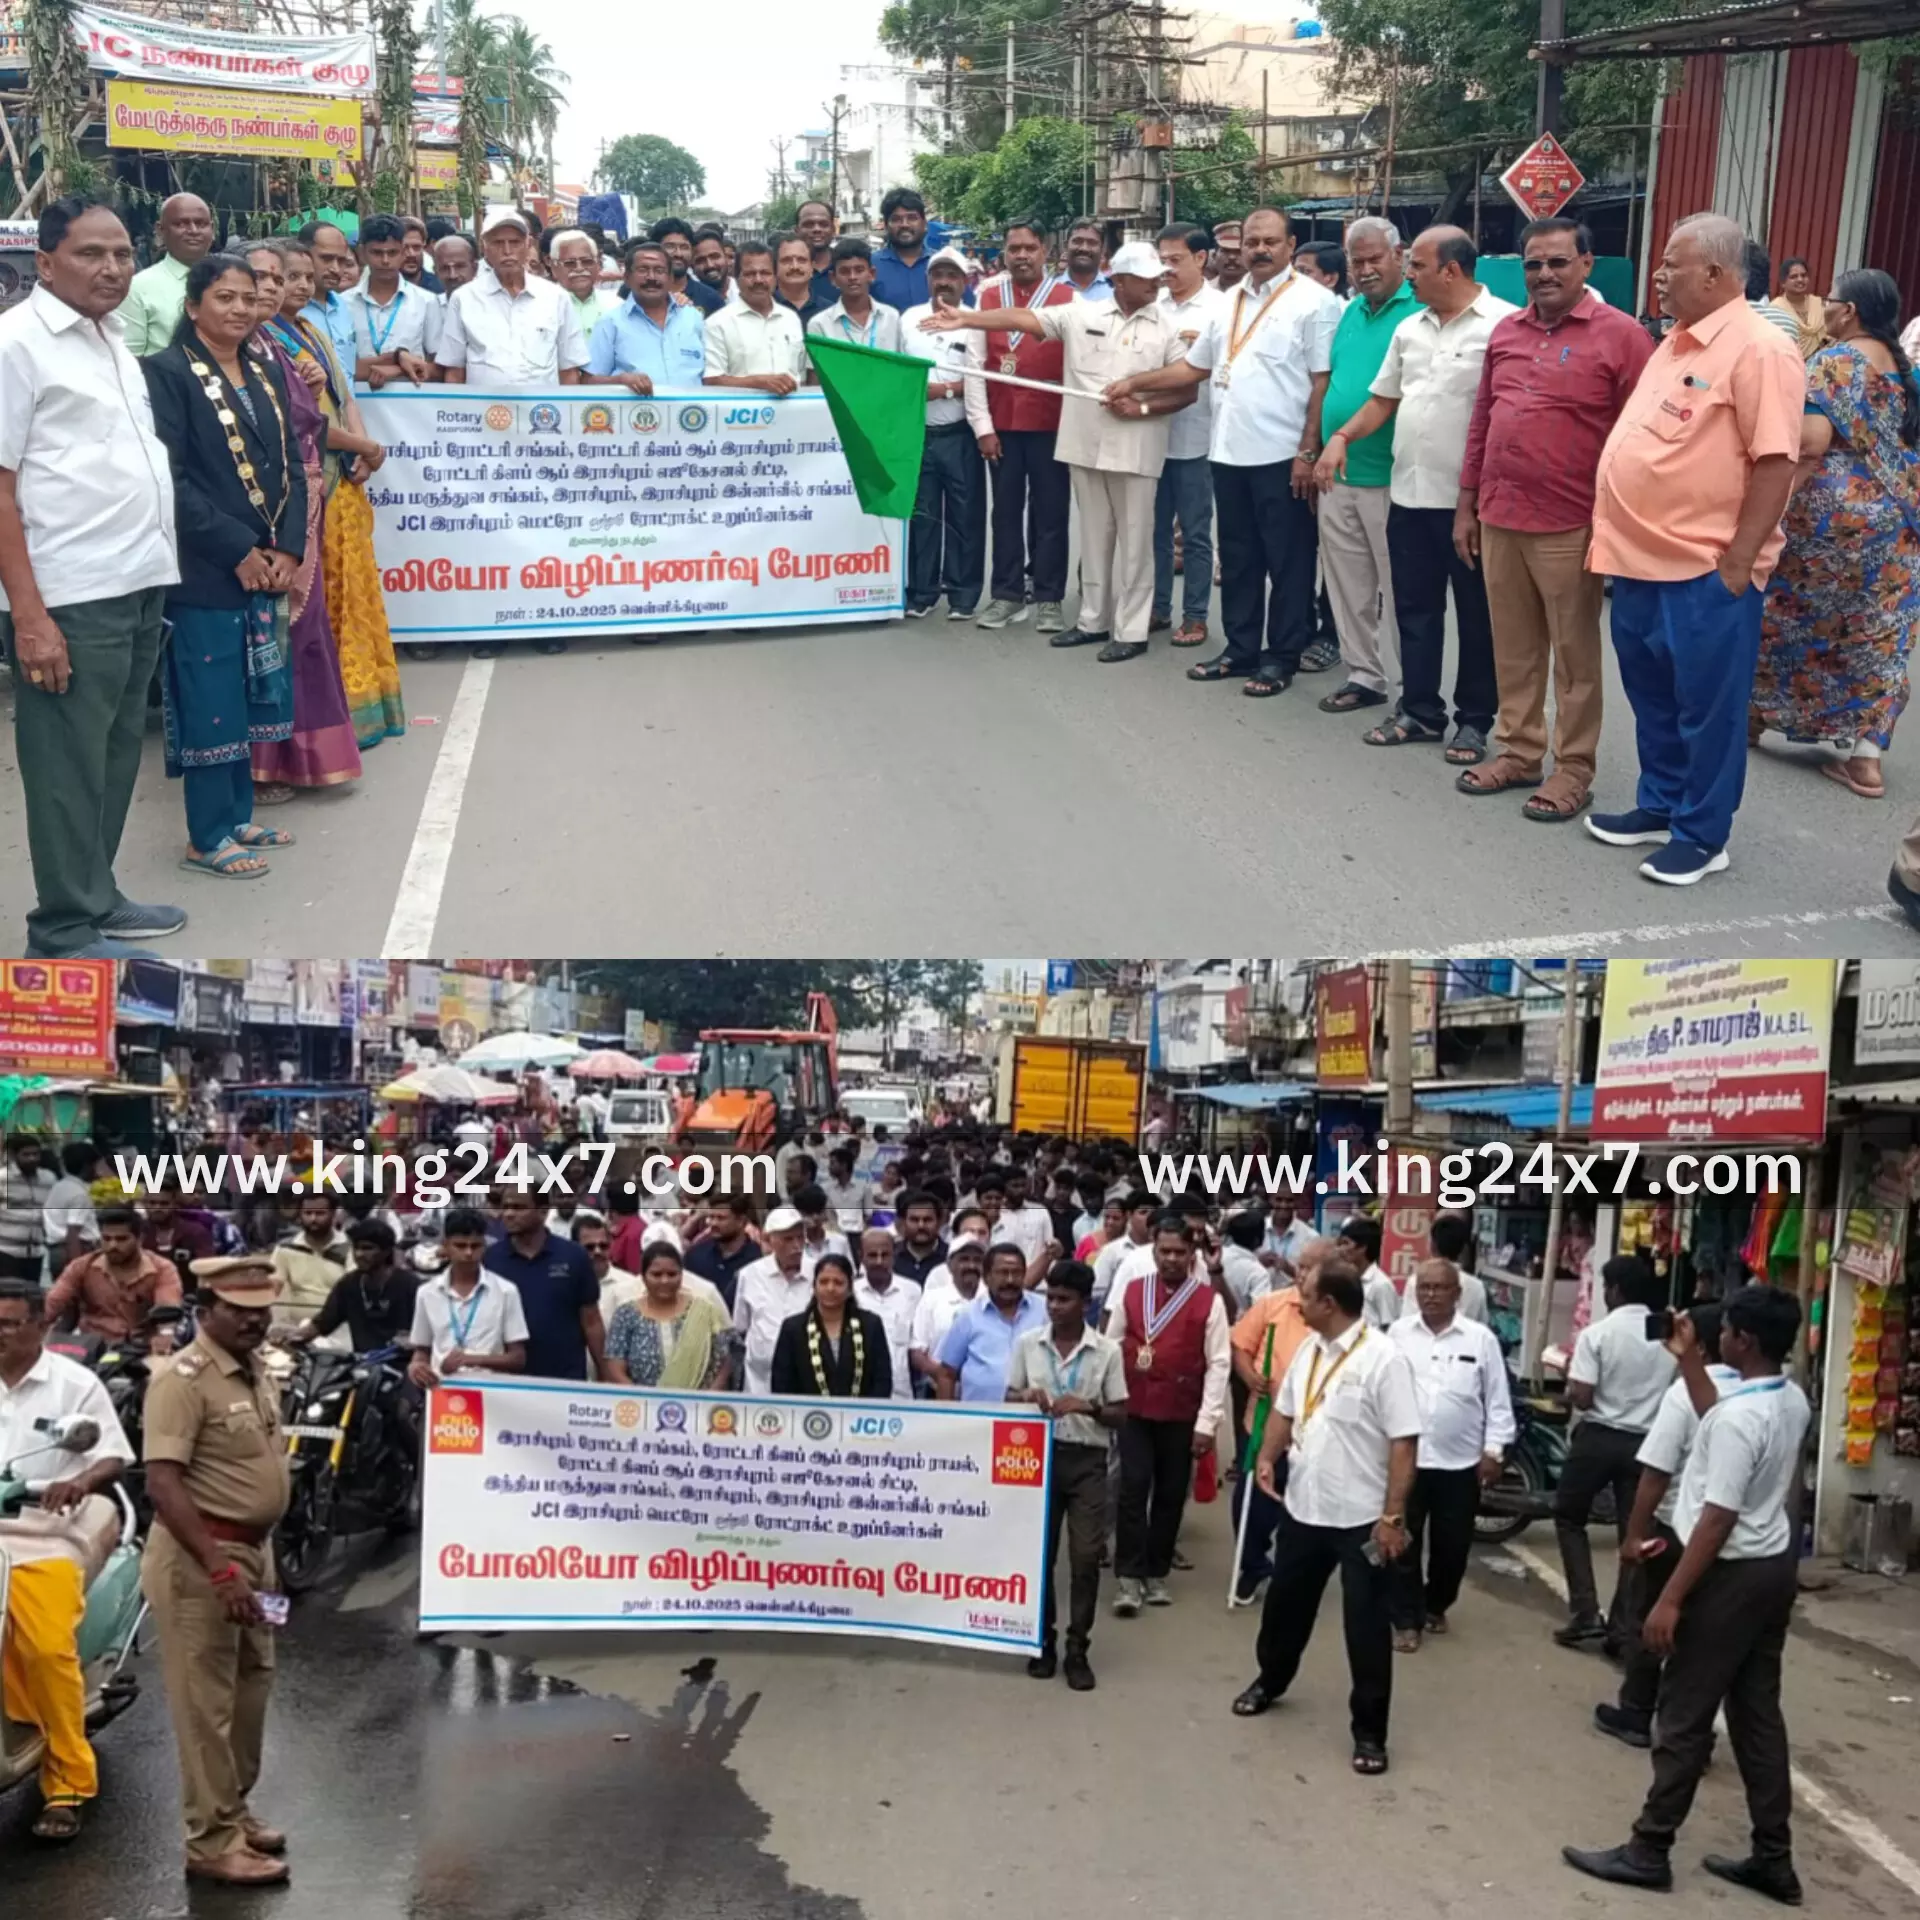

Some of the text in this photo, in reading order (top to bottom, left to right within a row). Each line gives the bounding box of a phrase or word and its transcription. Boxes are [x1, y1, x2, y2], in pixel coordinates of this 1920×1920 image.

[70, 26, 133, 58] IC
[141, 45, 304, 77] நண்பர்கள்
[312, 62, 370, 86] குழு
[231, 114, 320, 141] நண்பர்கள்
[323, 124, 358, 150] குழு
[436, 408, 759, 425] Rotary JCI
[446, 441, 510, 459] ரோட்டரி
[515, 440, 573, 458] சங்கம்,
[578, 440, 640, 458] ரோட்டரி
[686, 439, 717, 459] ஆப்
[720, 438, 795, 458] இராசிபுரம்
[423, 465, 487, 483] ரோட்டரி
[492, 464, 532, 481] கிளப்
[536, 462, 568, 481] ஆப்
[572, 461, 651, 482] இராசிபுரம்
[366, 486, 404, 507] ந்திய
[408, 486, 484, 508] மருத்துவ
[488, 485, 549, 505] சங்கம்,
[553, 483, 637, 505] இராசிபுரம்,
[641, 481, 718, 503] இராசிபுரம்
[807, 479, 856, 497] சங்கம்
[397, 515, 425, 531] JCI
[430, 512, 513, 533] இராசிபுரம்
[518, 512, 583, 531] மெட்ரோ
[711, 505, 813, 528] உறுப்பினர்கள்
[378, 544, 891, 599] லியோ விழிப்புணர்வு பேரணி
[495, 608, 526, 625] நாள்
[536, 603, 617, 620] 24.10.2025
[1687, 998, 1761, 1047] காமராஜ்
[568, 1403, 886, 1435] Rotary JCI
[531, 1501, 561, 1518] JCI
[438, 1543, 1028, 1606] போலியோ விழிப்புணர்வு பேரணி
[662, 1597, 741, 1613] 24.10.2025
